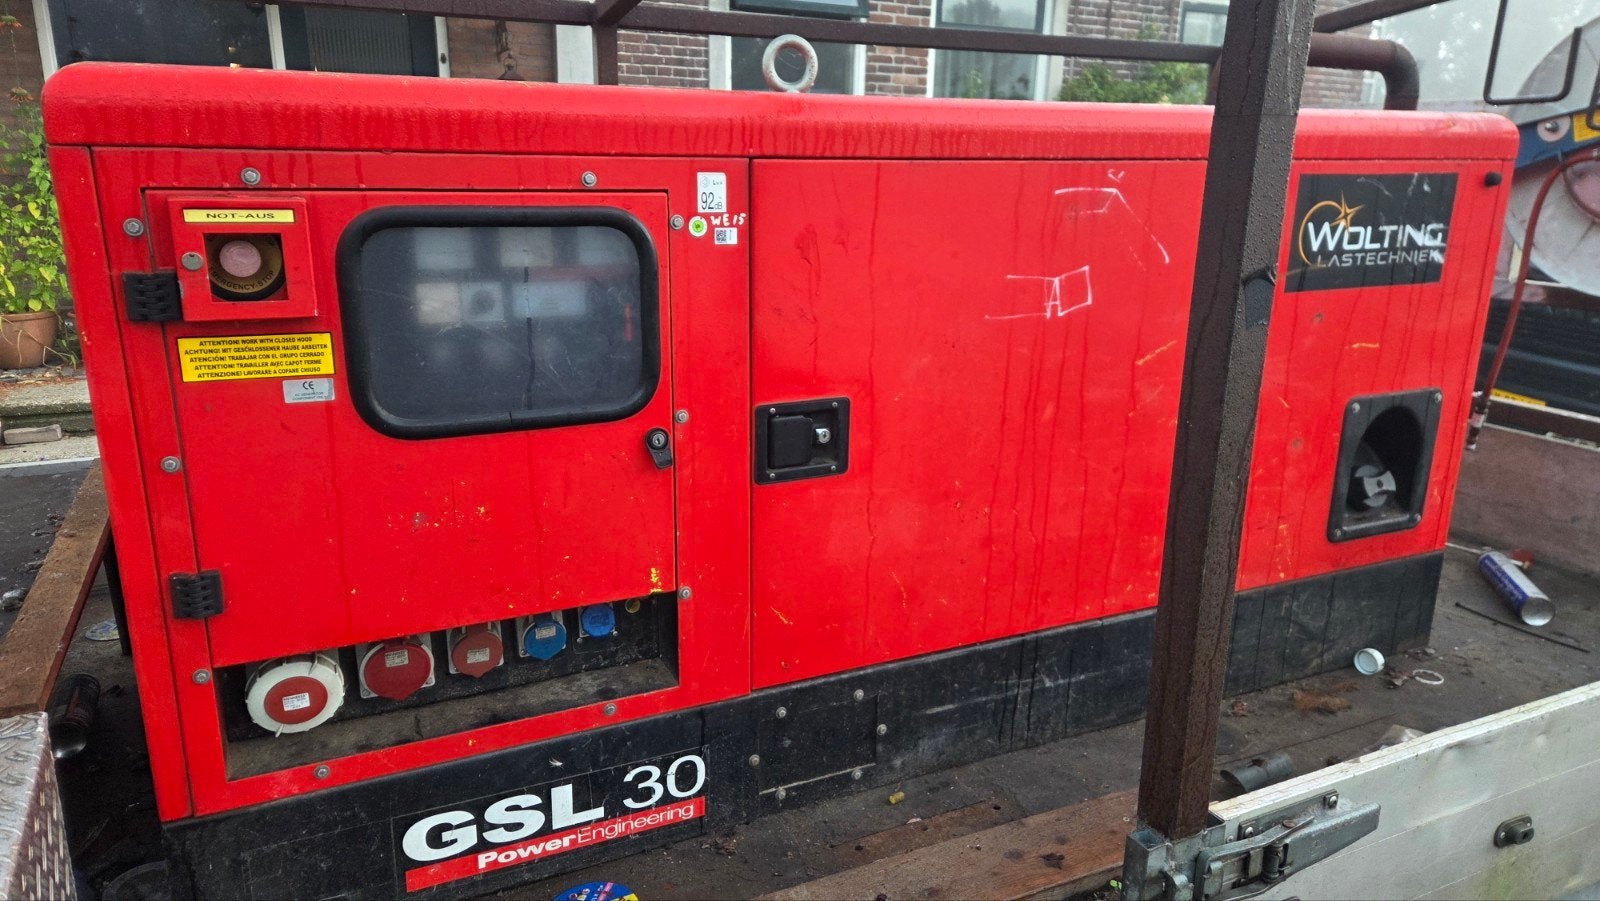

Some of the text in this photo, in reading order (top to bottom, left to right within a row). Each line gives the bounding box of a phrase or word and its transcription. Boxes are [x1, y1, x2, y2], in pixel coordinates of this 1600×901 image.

[1308, 222, 1444, 251] WOLTING
[1317, 250, 1444, 267] LASTECHNIEK
[303, 381, 314, 390] CE
[402, 755, 706, 861] GSL 30
